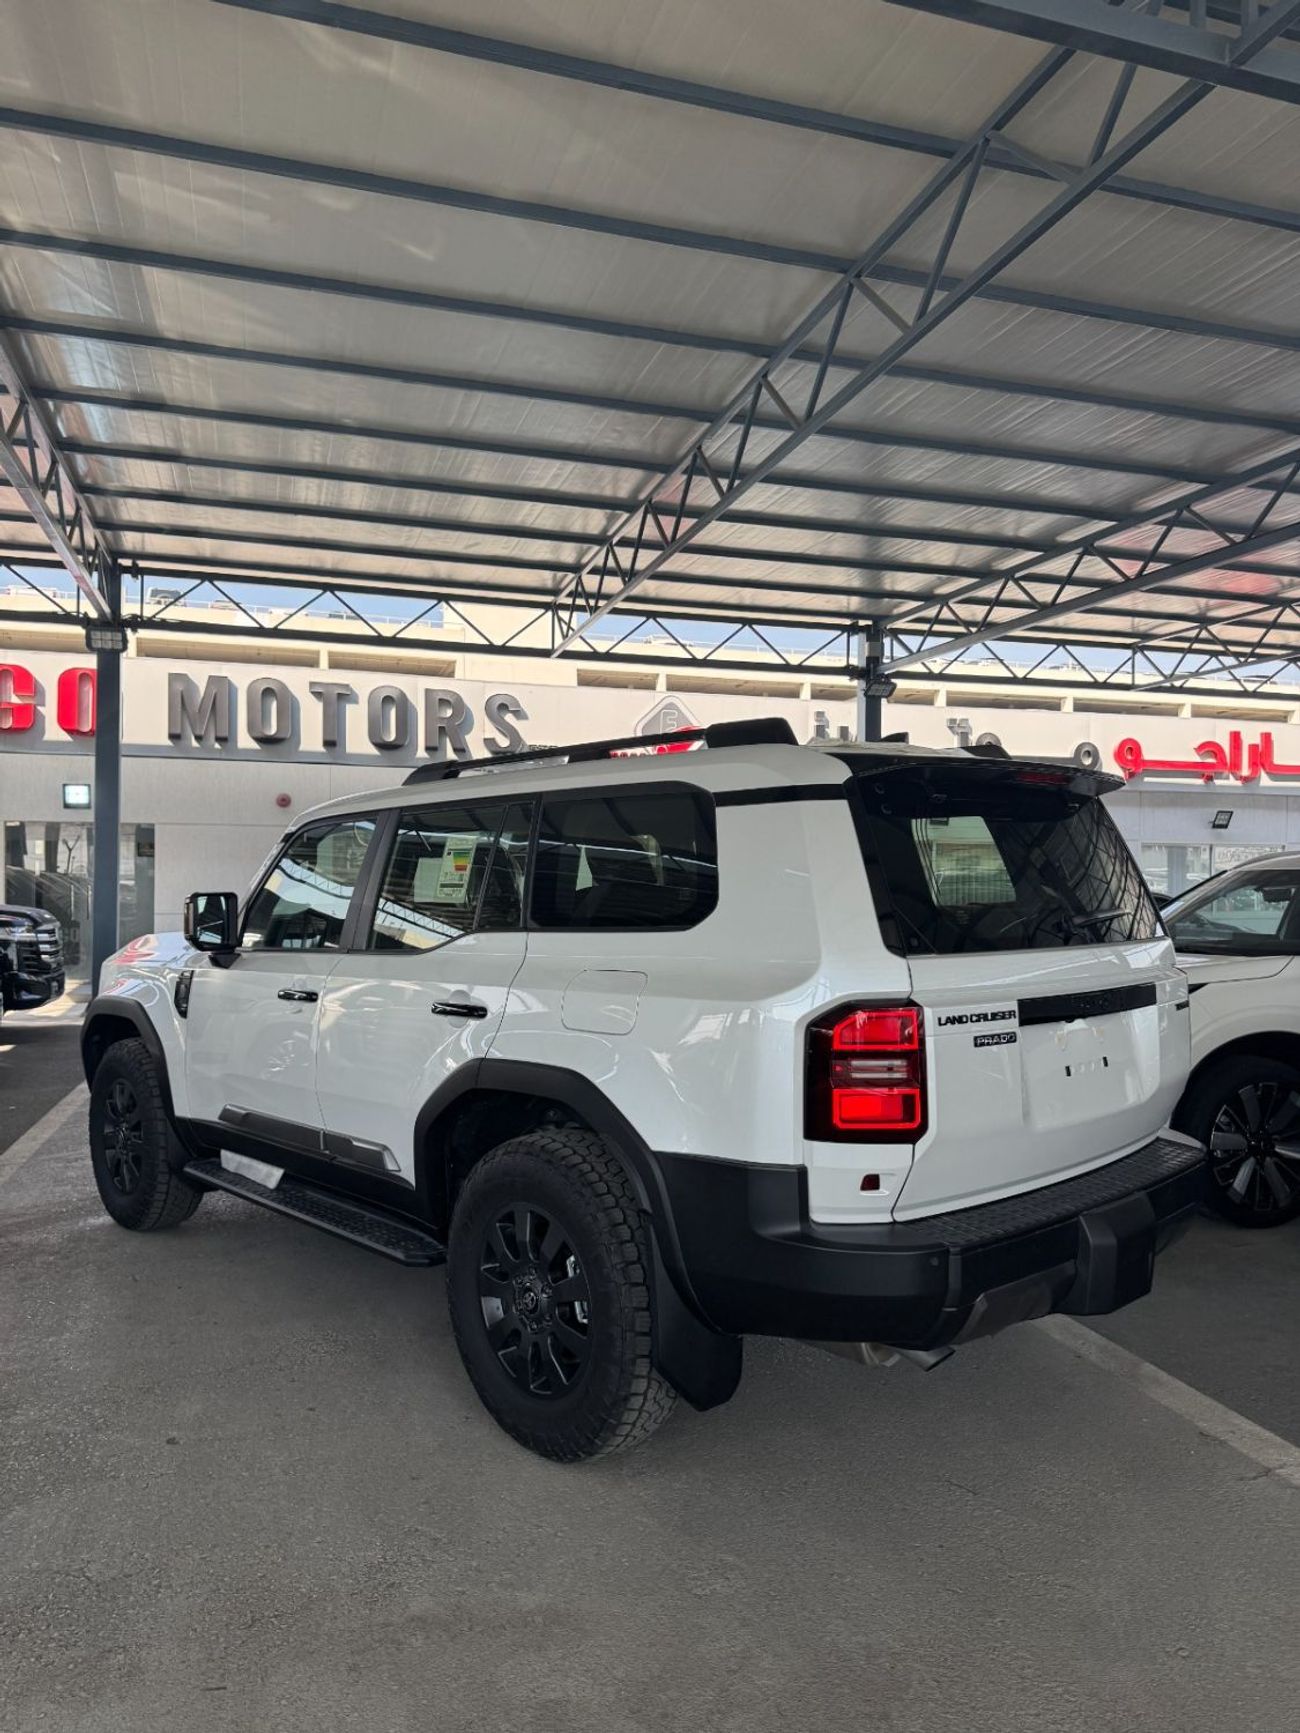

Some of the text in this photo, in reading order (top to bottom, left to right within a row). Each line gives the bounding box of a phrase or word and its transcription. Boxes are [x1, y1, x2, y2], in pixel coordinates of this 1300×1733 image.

[168, 672, 529, 754] MOTORS
[937, 1009, 1017, 1027] LAND CRUISER
[976, 1033, 1016, 1046] PRADO
